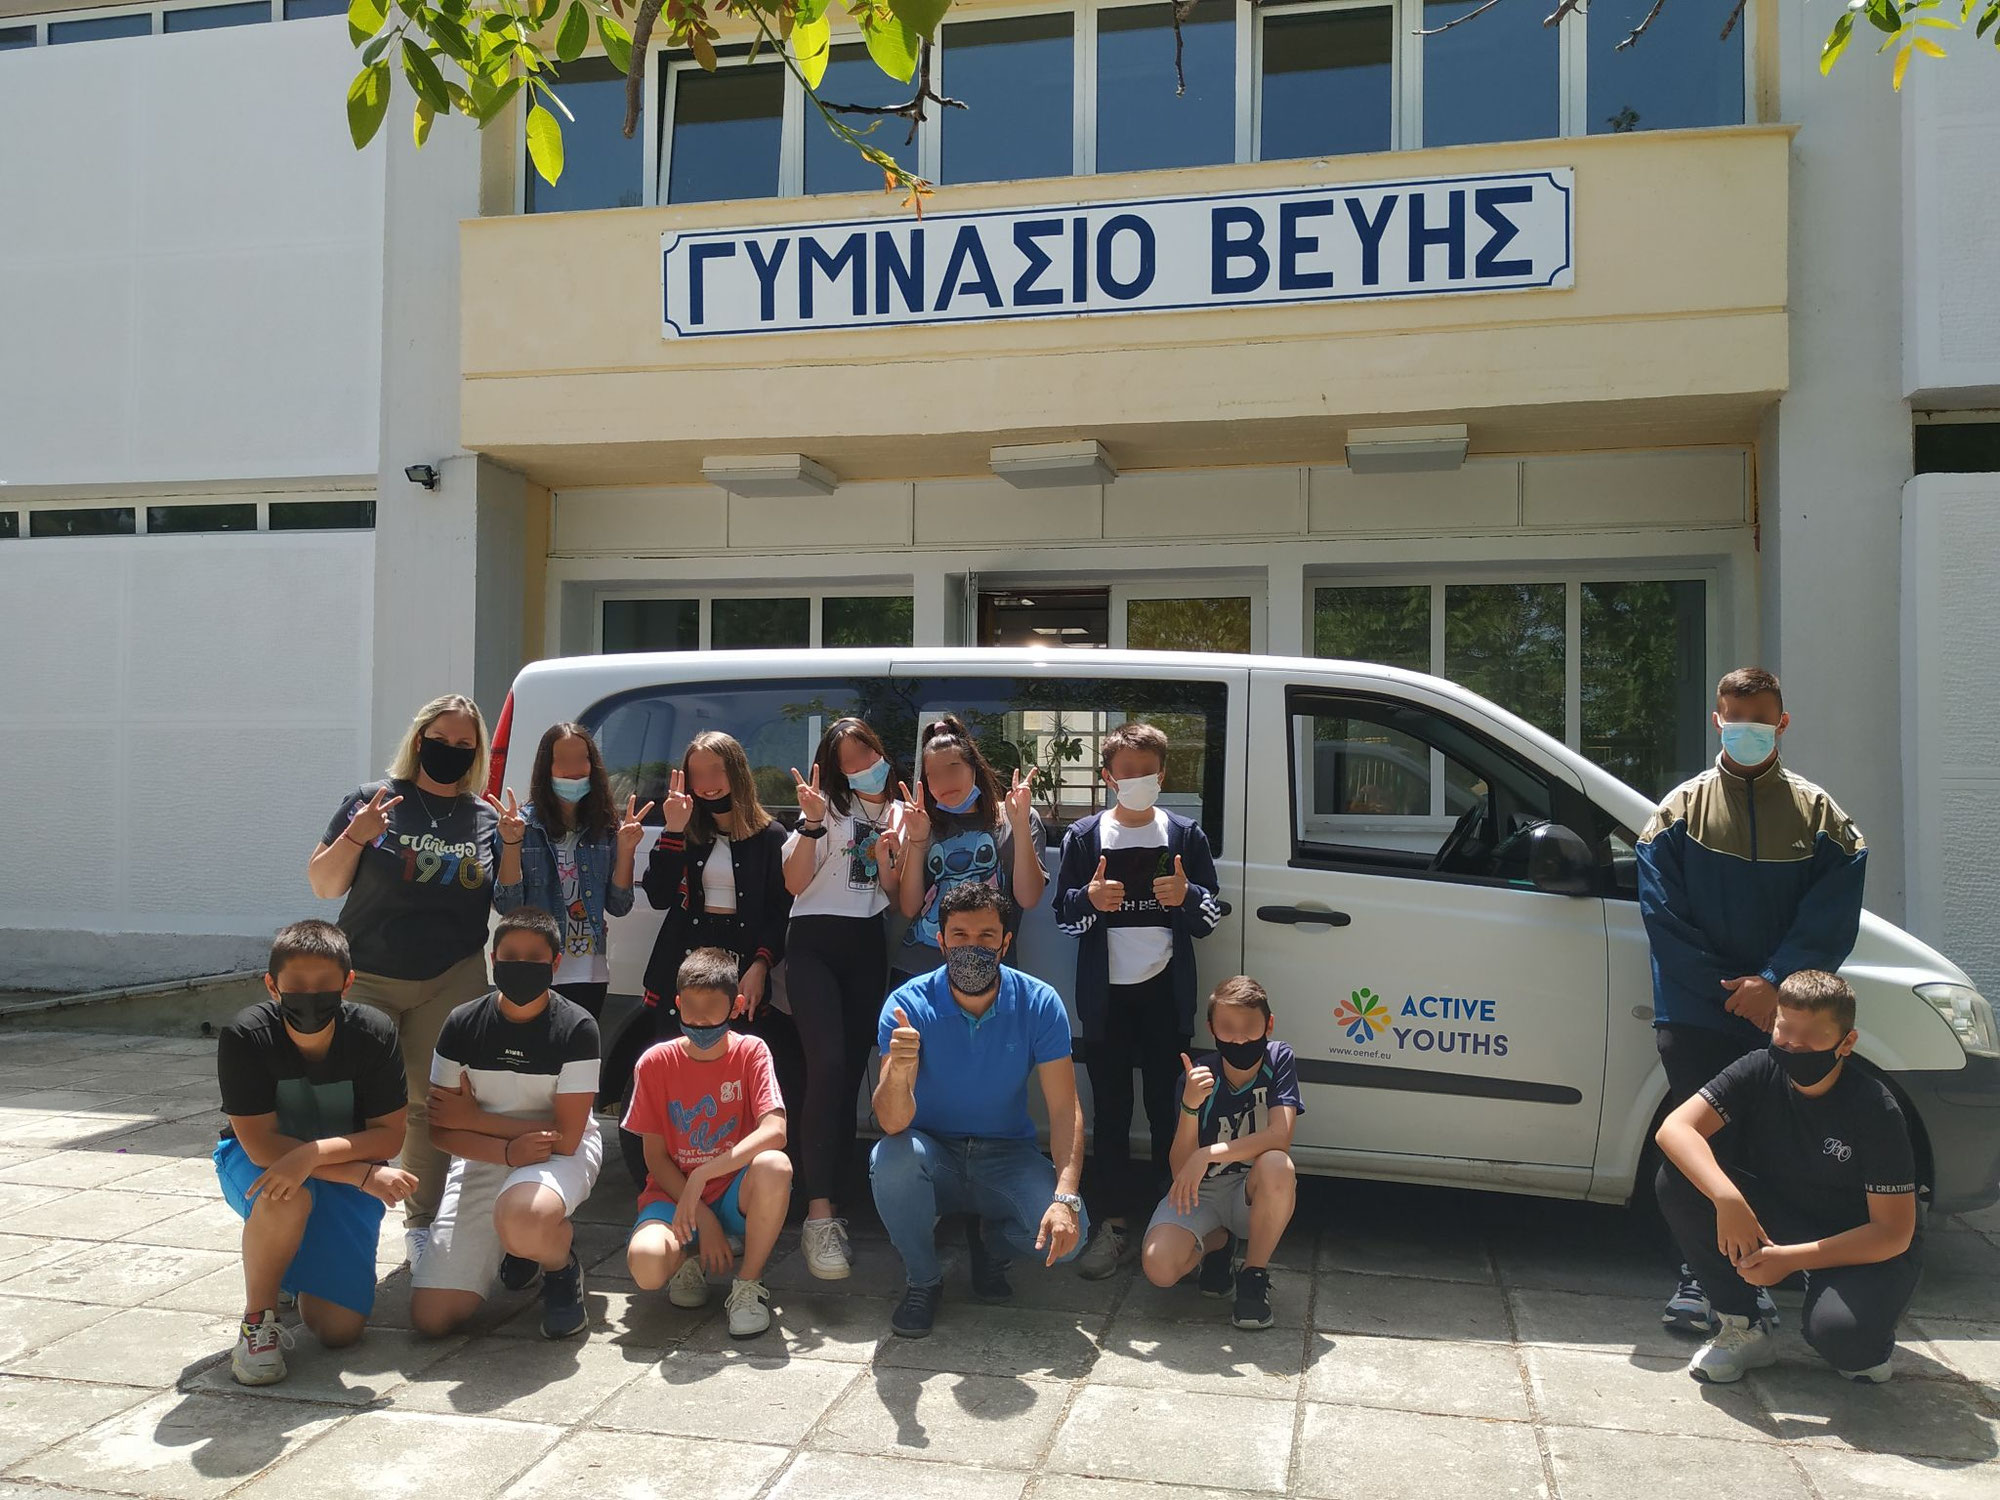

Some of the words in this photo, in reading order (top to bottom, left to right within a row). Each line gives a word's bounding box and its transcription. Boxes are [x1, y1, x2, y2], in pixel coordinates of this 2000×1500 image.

[688, 213, 1157, 325] ΓΥΜΝΑΣΙΟ
[1211, 185, 1534, 295] ΒΕΥΗΣ
[399, 834, 477, 858] Vintage
[401, 848, 485, 890] 1970
[1400, 995, 1496, 1022] ACTIVE
[1329, 1047, 1392, 1060] www.oenef.eu
[1392, 1027, 1509, 1057] YOUTHS
[720, 1079, 743, 1103] 81
